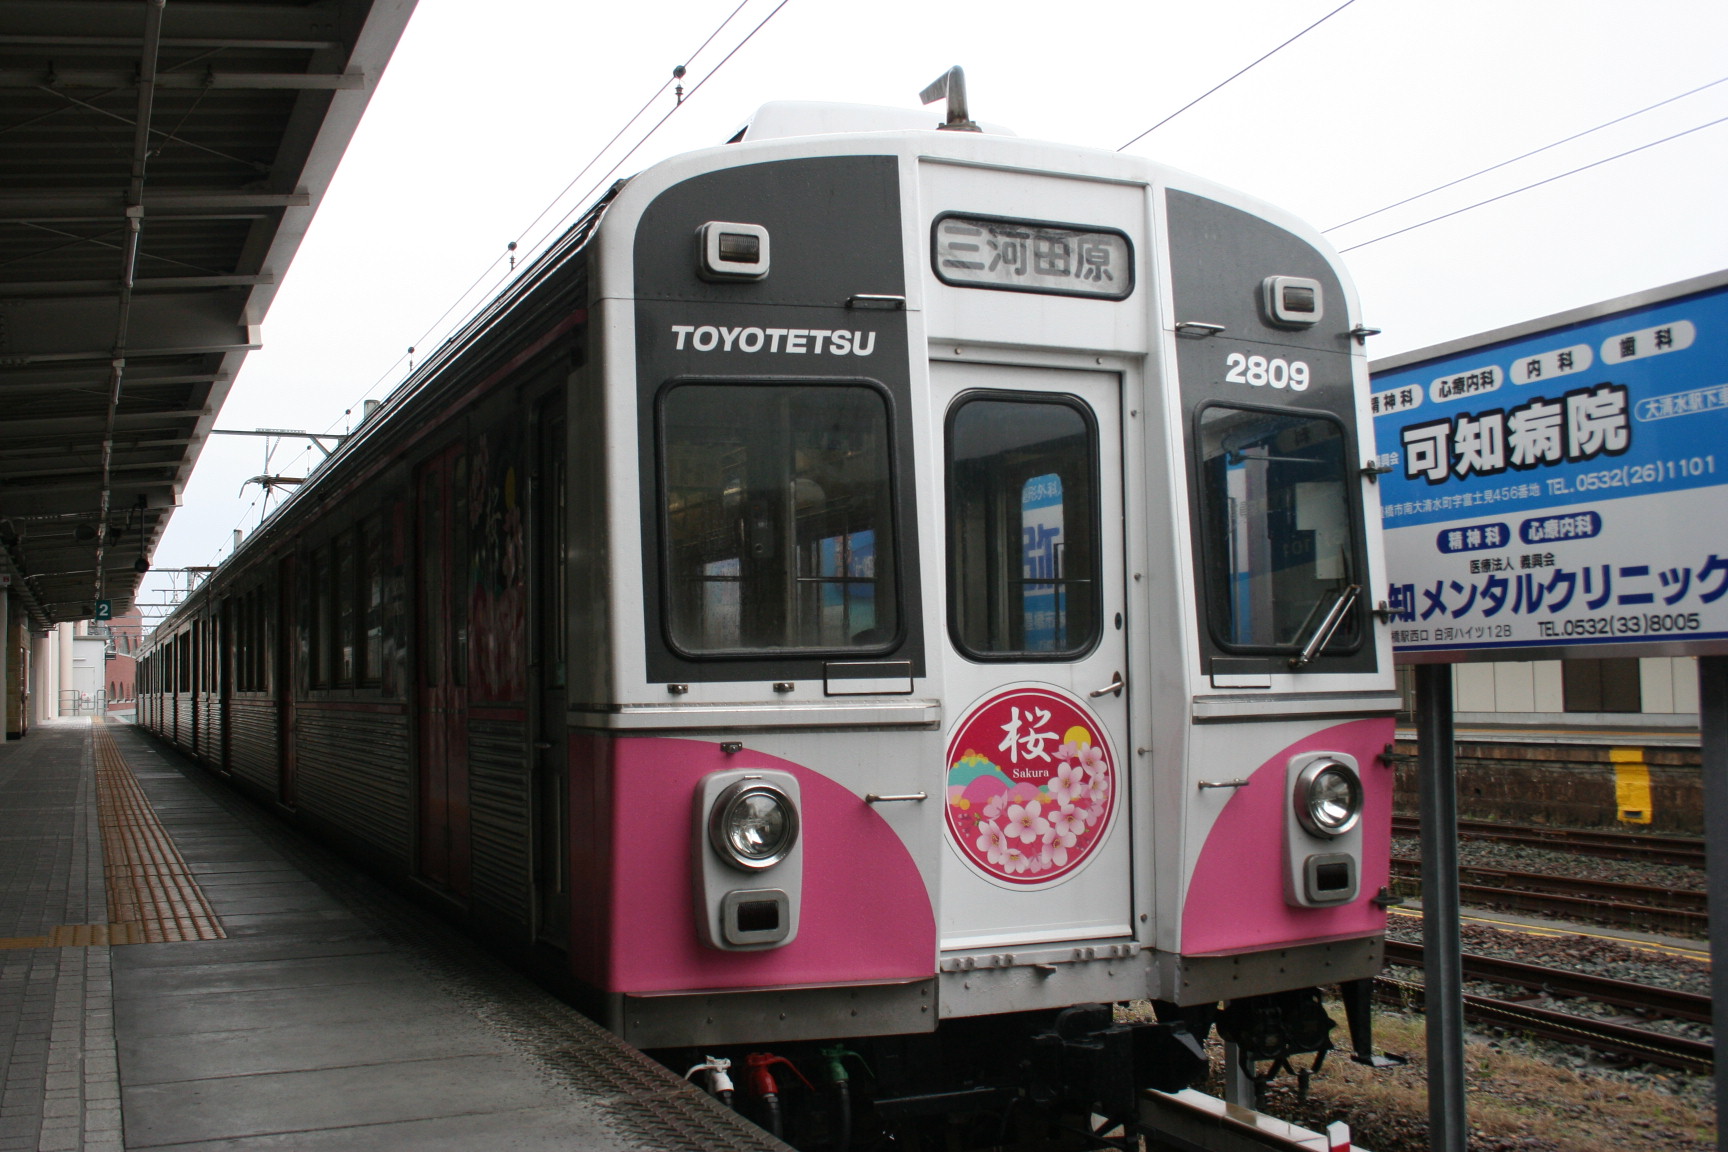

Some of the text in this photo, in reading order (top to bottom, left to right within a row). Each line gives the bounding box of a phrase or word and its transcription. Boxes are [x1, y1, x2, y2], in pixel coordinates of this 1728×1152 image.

[943, 226, 1113, 282] 三河田原
[671, 325, 876, 356] TOYOTETSU
[1225, 352, 1310, 391] 2809
[1438, 369, 1495, 399] 心療内科
[1527, 350, 1574, 379] 内科
[1619, 327, 1672, 358] 歯科
[1402, 385, 1629, 482] 可知病院
[1448, 515, 1594, 550] 精神科 心療内科
[1470, 558, 1514, 574] 医療法人
[1388, 554, 1728, 624] 知メンタルクリニック
[99, 603, 109, 616] 2
[1538, 612, 1700, 637] TEL.0532(33)8005
[998, 705, 1060, 764] 桜
[1012, 768, 1050, 778] Sakura
